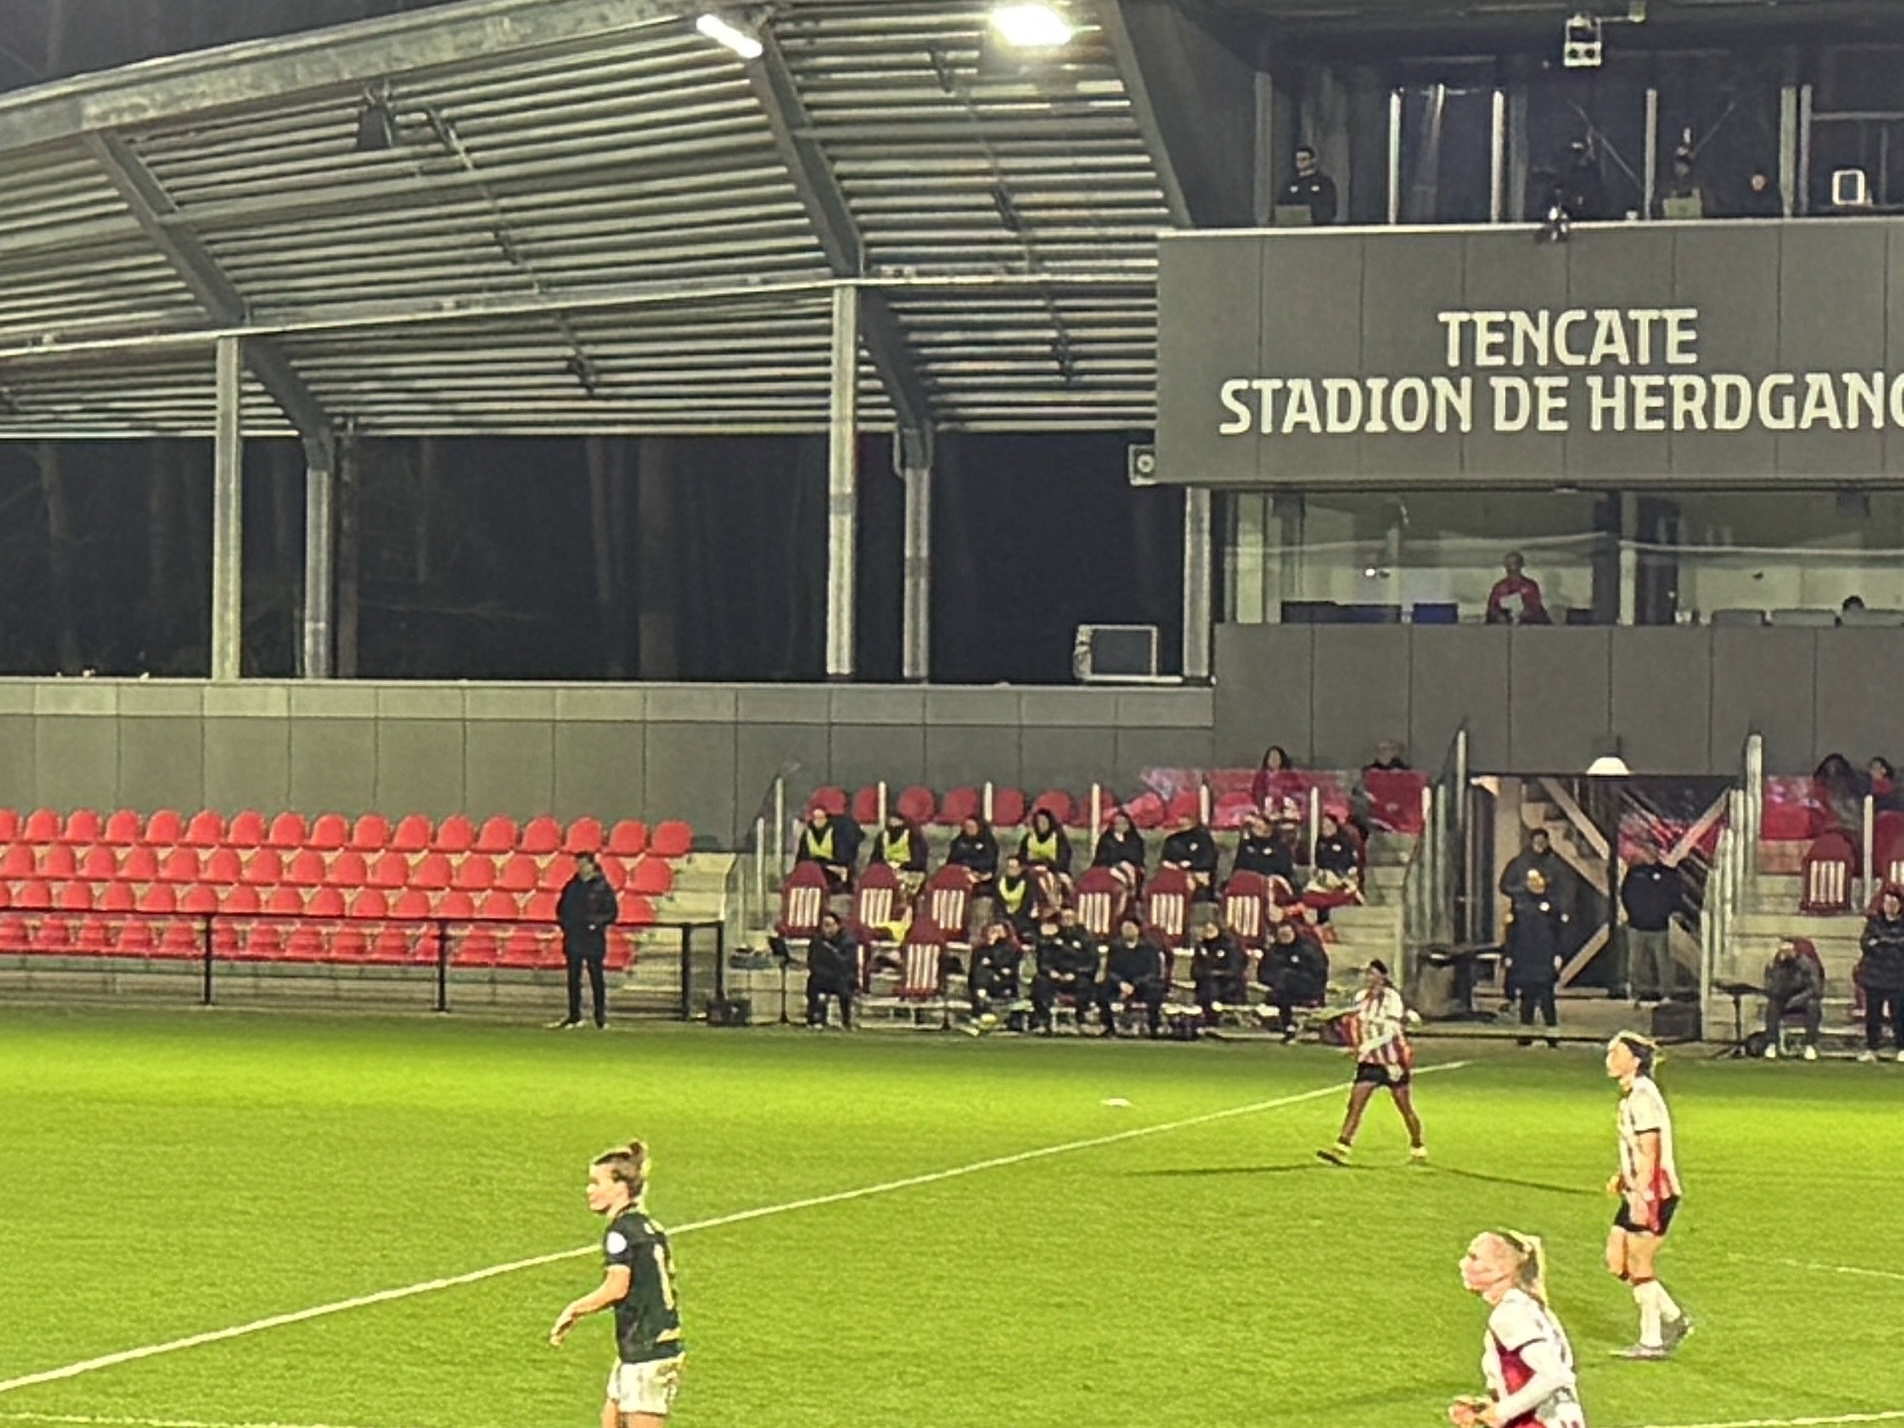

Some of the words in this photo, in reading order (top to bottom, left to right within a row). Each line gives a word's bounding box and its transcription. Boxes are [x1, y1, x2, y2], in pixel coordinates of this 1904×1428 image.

[1437, 309, 1698, 367] TENCATE
[1218, 376, 1472, 434] STADION
[1489, 376, 1569, 432] DE
